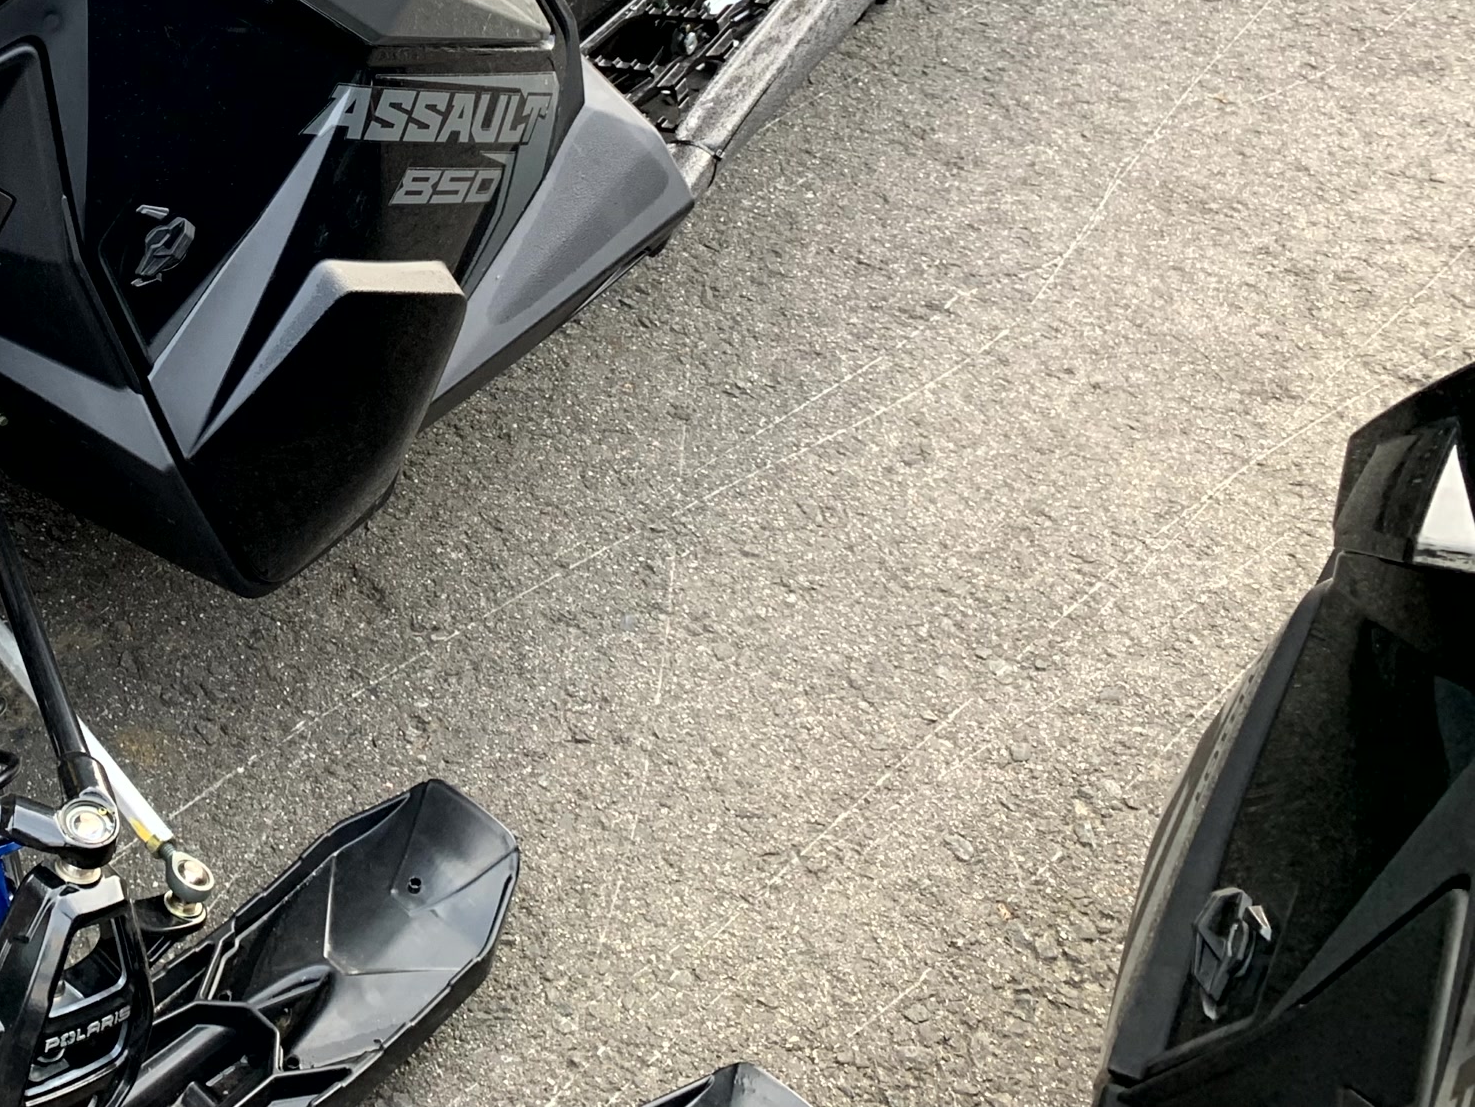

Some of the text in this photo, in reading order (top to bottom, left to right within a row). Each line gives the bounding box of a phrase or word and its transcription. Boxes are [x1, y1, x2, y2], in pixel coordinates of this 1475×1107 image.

[298, 82, 551, 144] ASSAULT
[387, 166, 503, 206] 850
[45, 1005, 131, 1053] POLARIS
